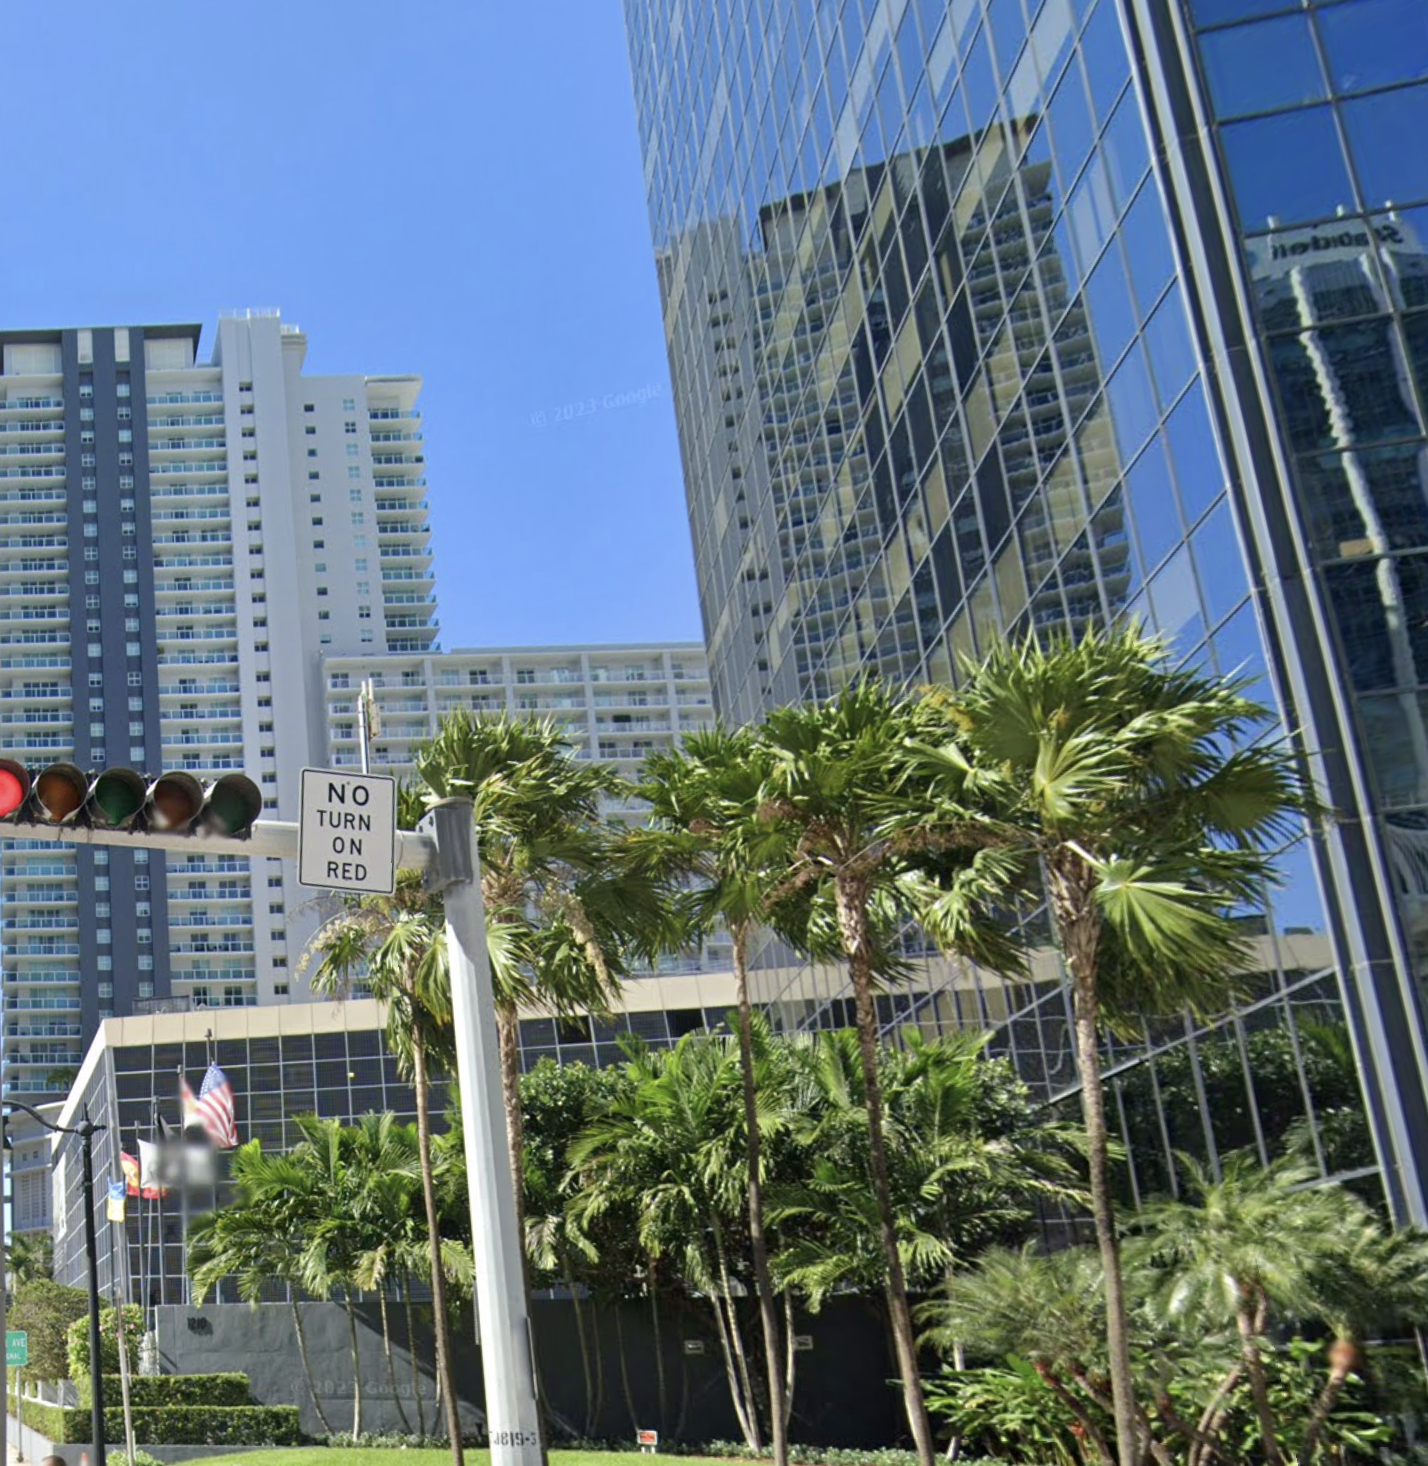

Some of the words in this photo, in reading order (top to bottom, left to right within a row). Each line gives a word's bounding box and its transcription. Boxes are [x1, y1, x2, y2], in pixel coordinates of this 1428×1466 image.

[327, 782, 370, 807] NO
[316, 809, 371, 832] TURN
[332, 836, 363, 856] ON
[327, 861, 367, 881] RED
